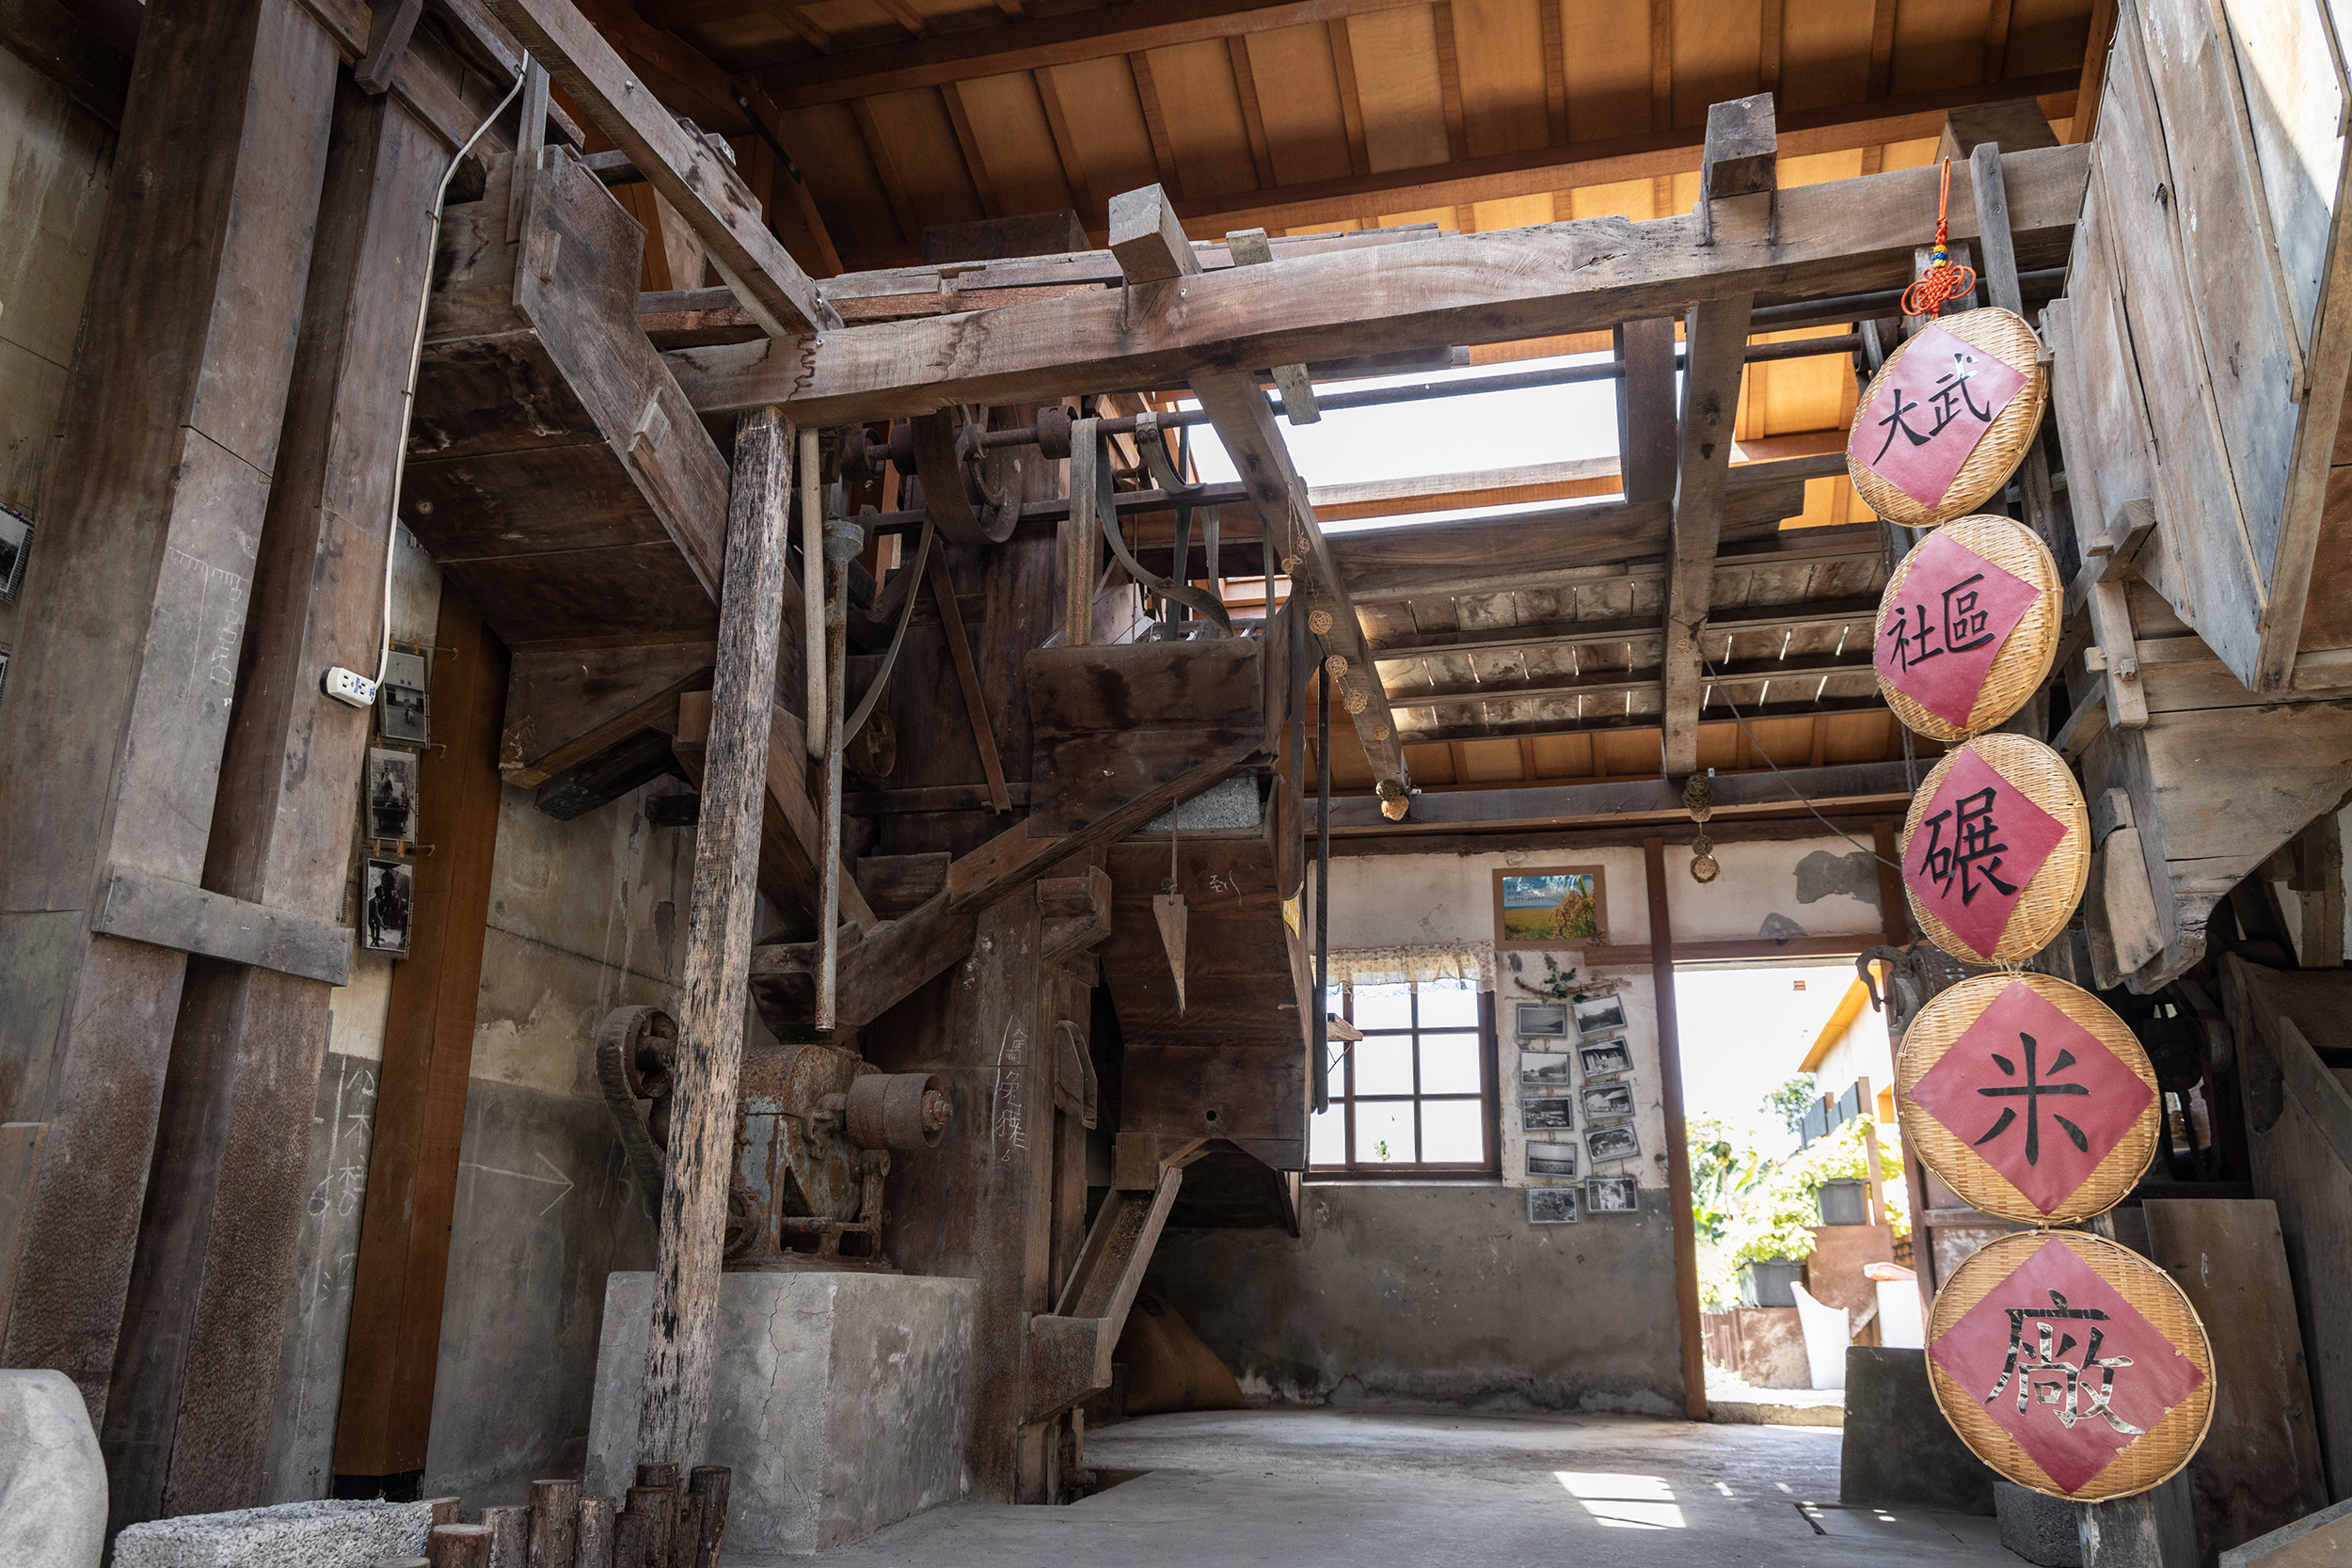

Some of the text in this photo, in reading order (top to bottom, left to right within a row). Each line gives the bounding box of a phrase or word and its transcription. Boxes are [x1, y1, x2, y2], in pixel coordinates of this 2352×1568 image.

[1871, 353, 1992, 467] 大武
[1886, 573, 1995, 673] 社區
[1918, 786, 2019, 906] 碾
[1973, 1032, 2090, 1167] 米
[1982, 1288, 2147, 1435] 廠
